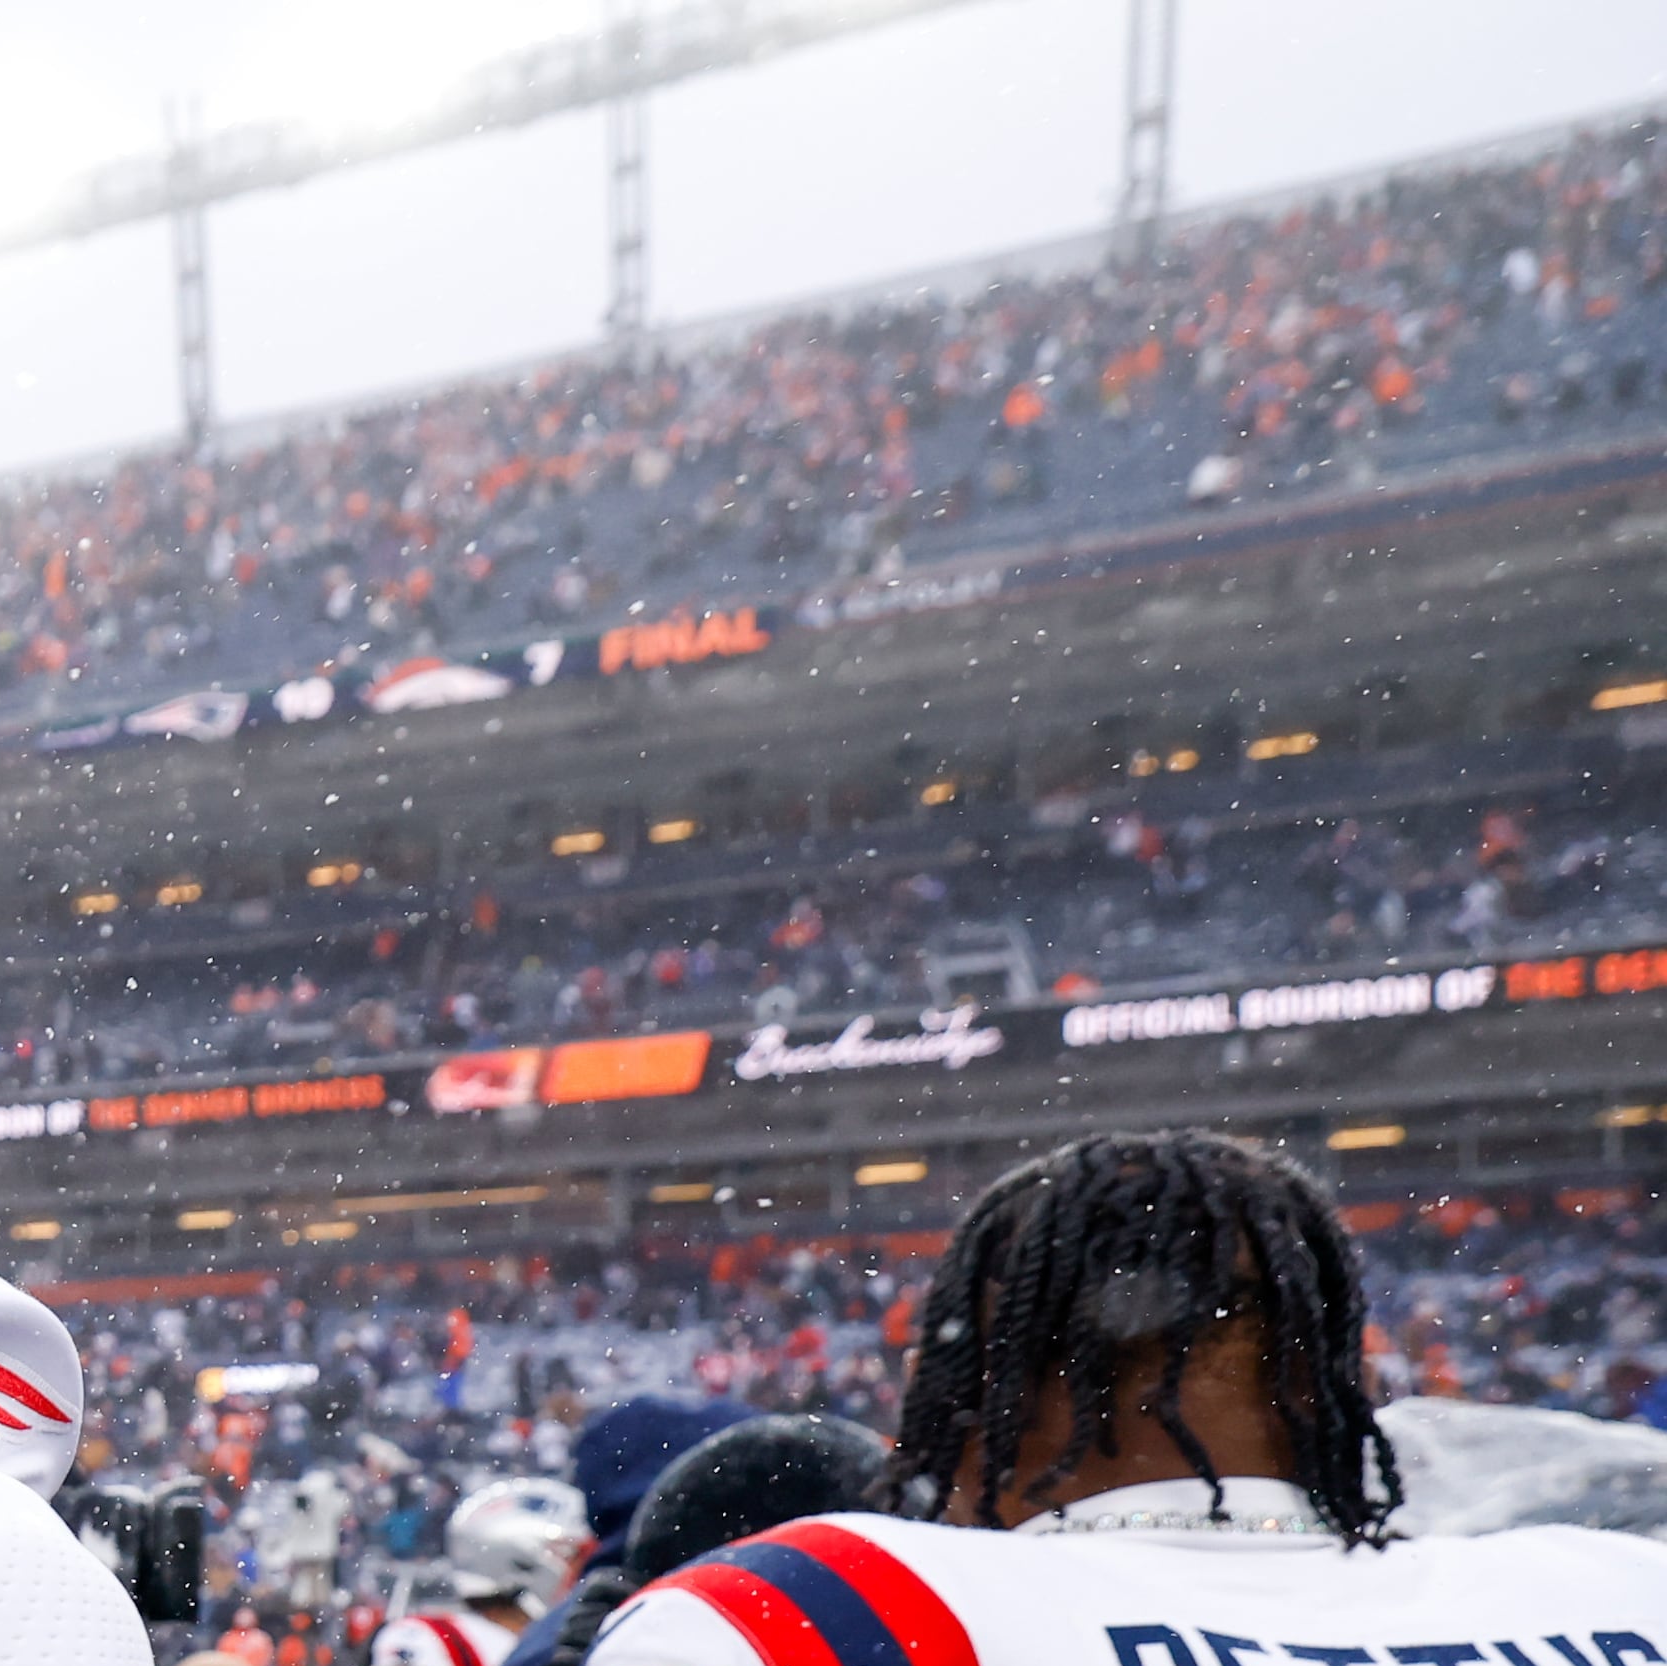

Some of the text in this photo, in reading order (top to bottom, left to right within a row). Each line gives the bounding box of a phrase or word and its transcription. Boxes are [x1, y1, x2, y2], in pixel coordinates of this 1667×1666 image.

[599, 608, 769, 676] FINAL
[1062, 992, 1236, 1046] OFFICIAL
[1238, 972, 1432, 1030] BOURBON
[1434, 964, 1497, 1012] OF
[46, 1099, 86, 1137] OF
